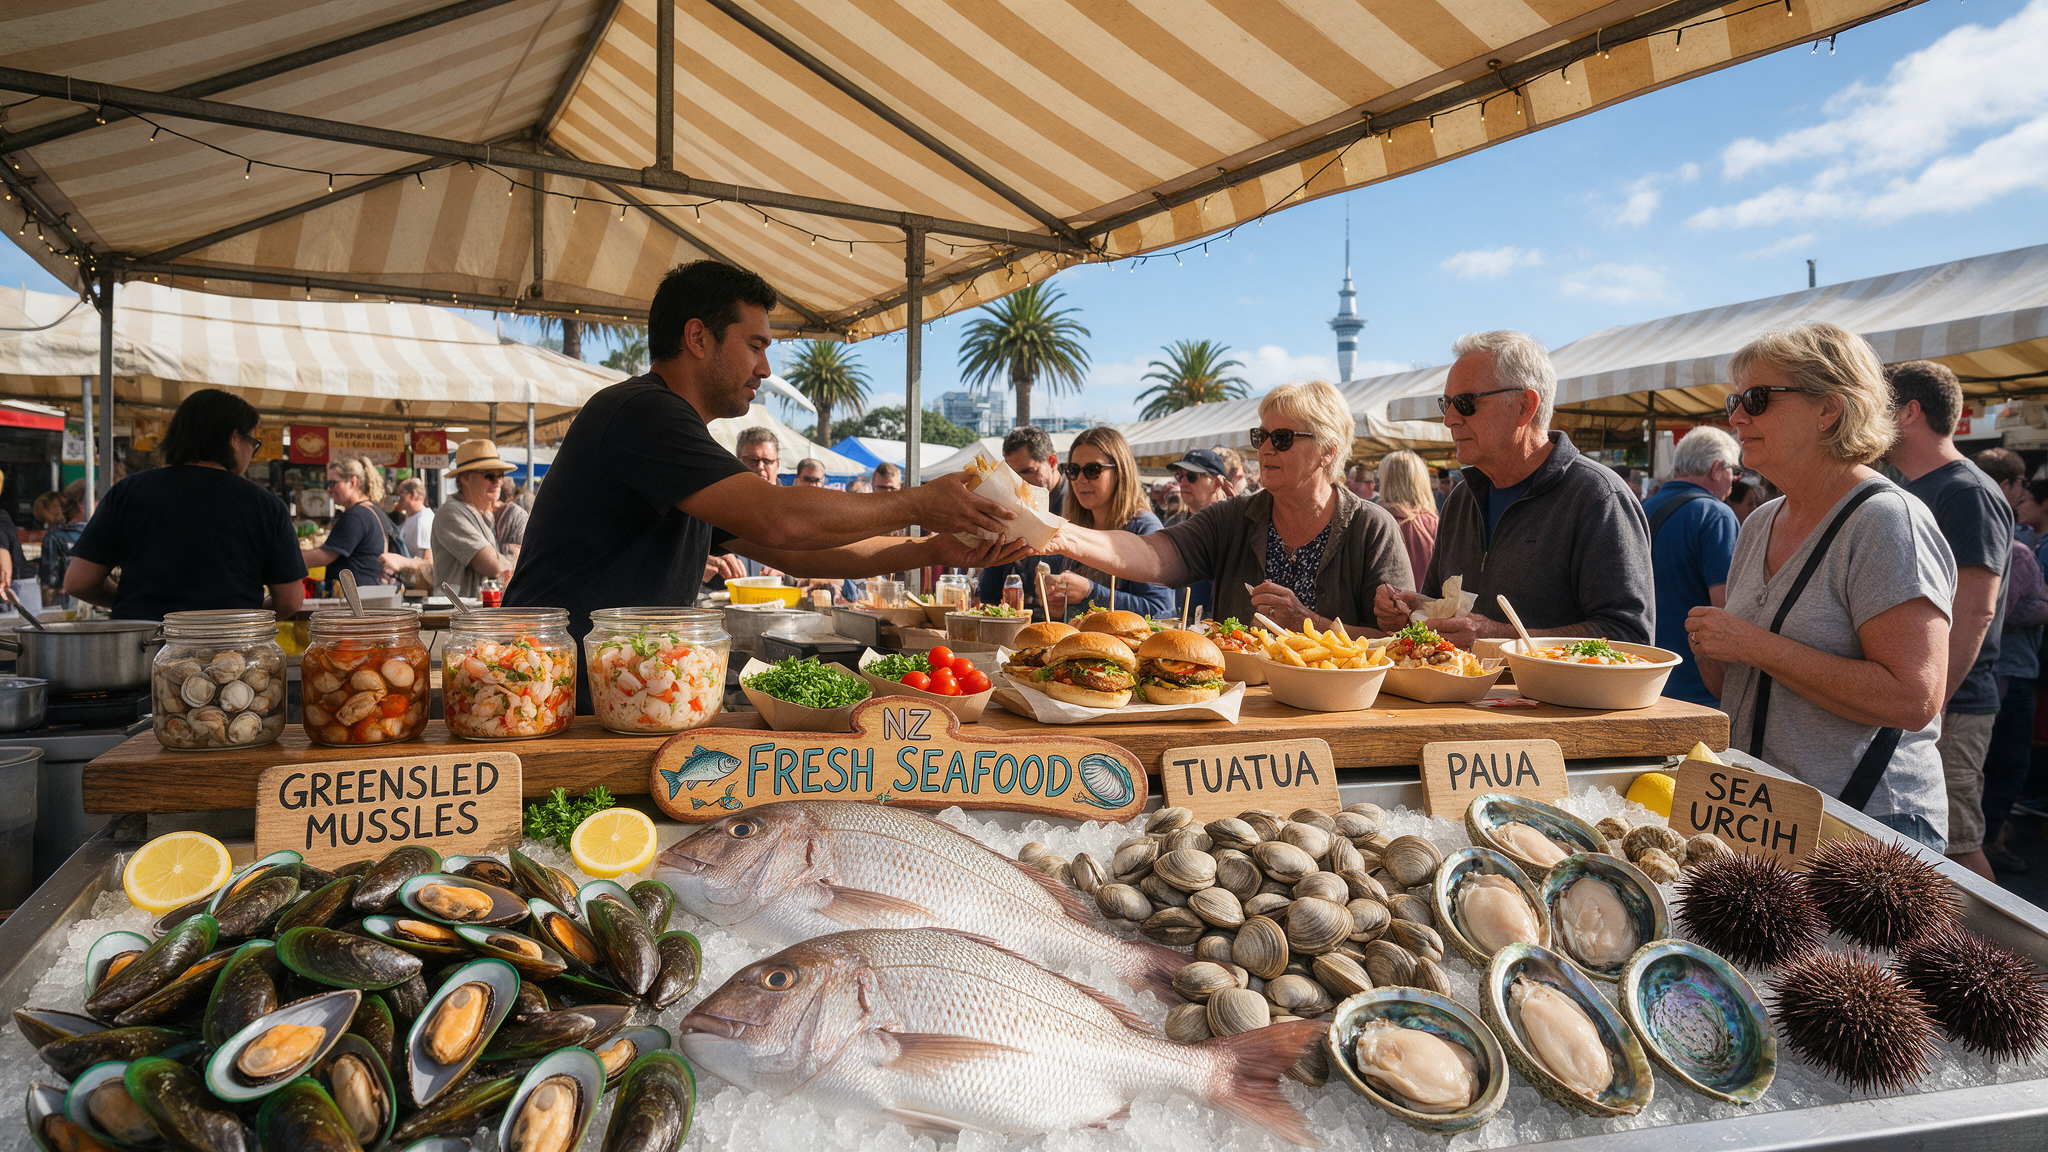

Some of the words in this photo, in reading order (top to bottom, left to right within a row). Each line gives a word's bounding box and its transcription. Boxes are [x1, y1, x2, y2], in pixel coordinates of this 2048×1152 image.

[883, 707, 931, 741] NZ
[278, 761, 499, 810] GREENSLED
[746, 742, 875, 797] FRESH
[892, 745, 1072, 798] SEAFOOD
[1172, 750, 1320, 796] TUATUA
[1447, 750, 1540, 791] PAUA
[1705, 772, 1773, 813] SEA
[305, 800, 479, 850] MUSSLES
[1690, 801, 1798, 855] URCIH
